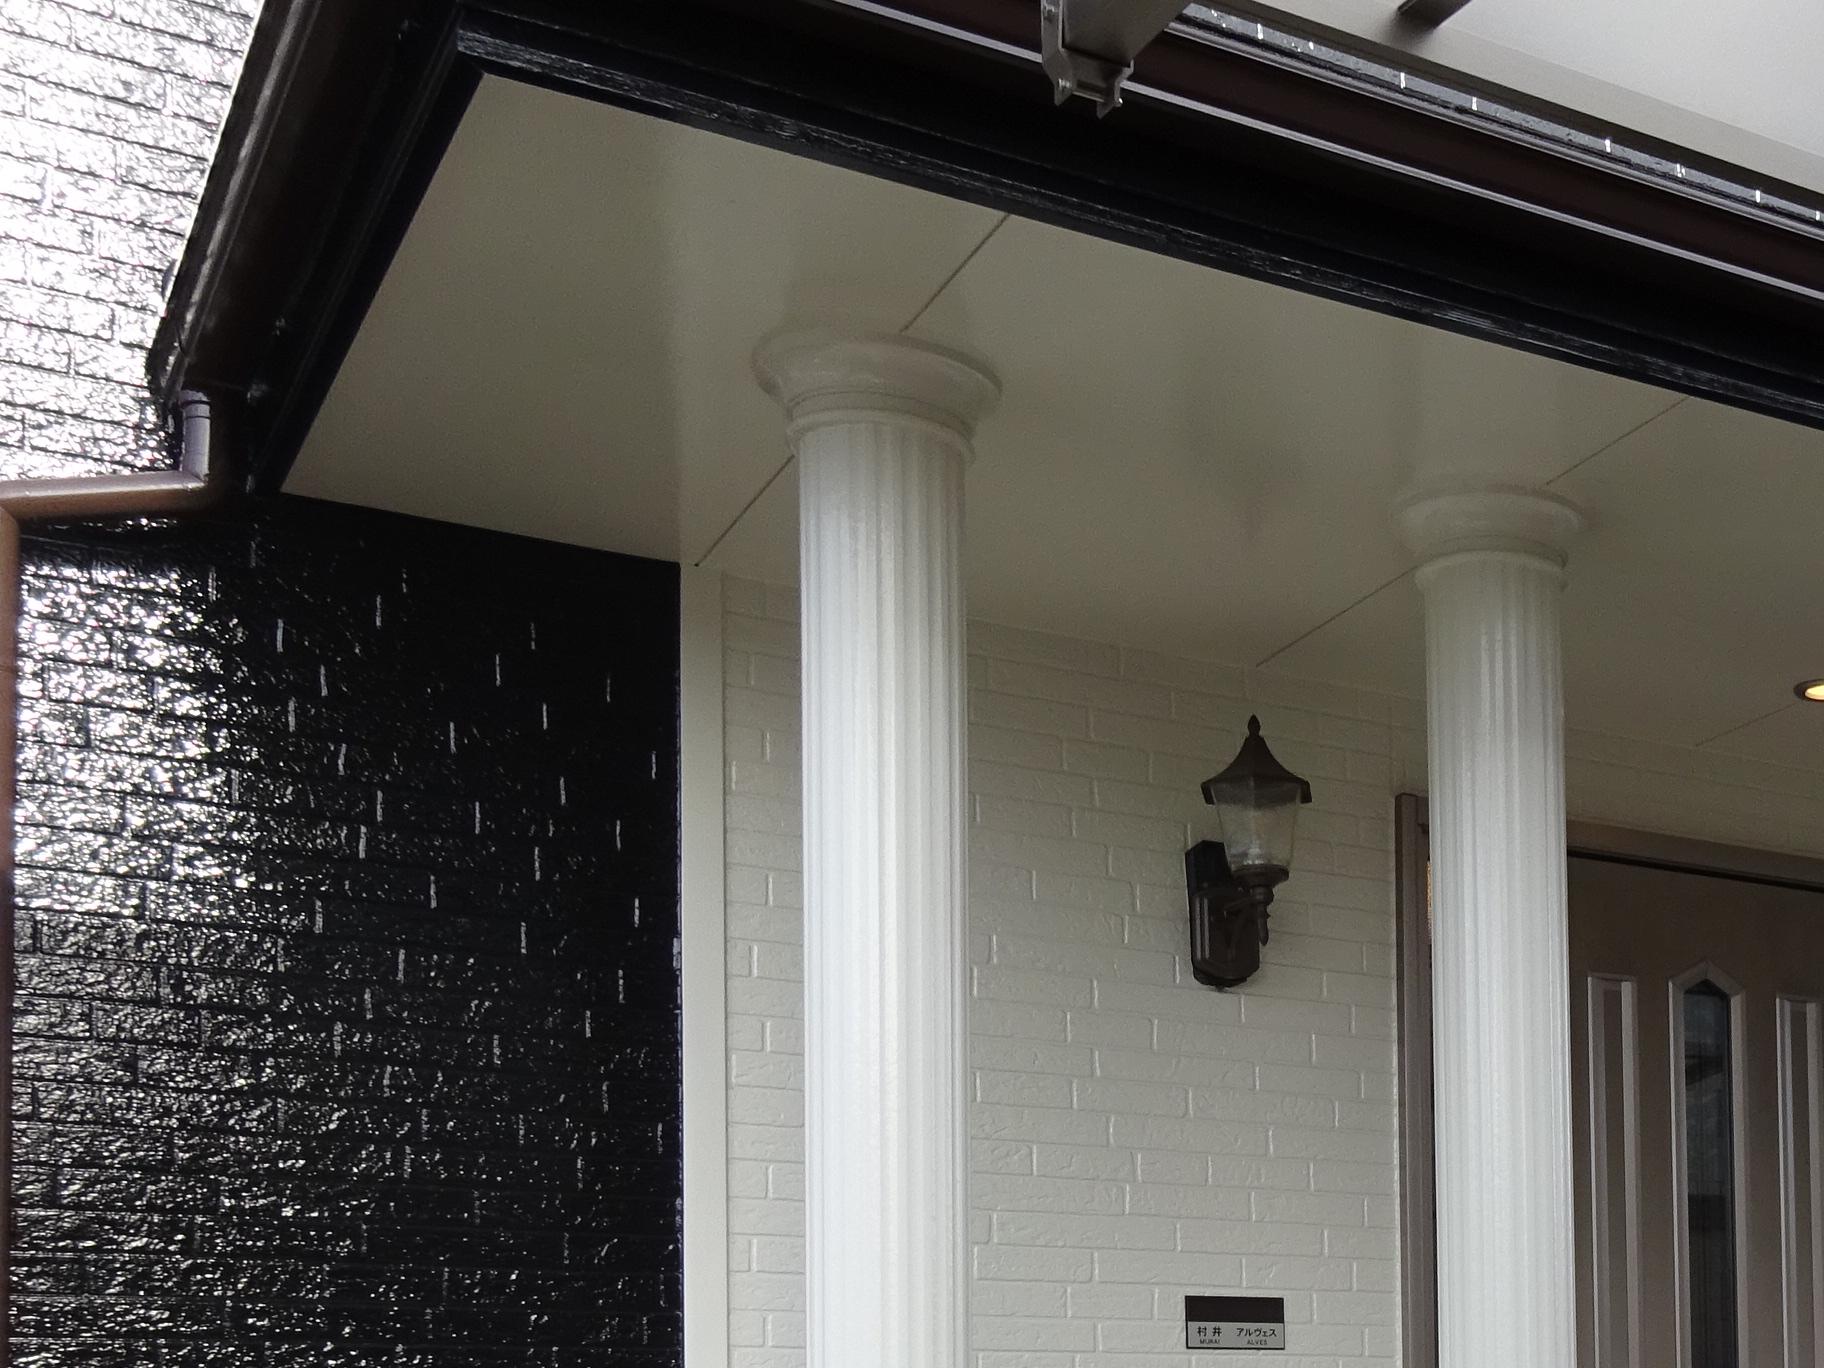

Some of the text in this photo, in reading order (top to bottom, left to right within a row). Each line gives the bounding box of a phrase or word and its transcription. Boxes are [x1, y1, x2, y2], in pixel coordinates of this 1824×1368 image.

[1236, 1327, 1277, 1338] アルヴェス
[1199, 1338, 1221, 1346] MURAI
